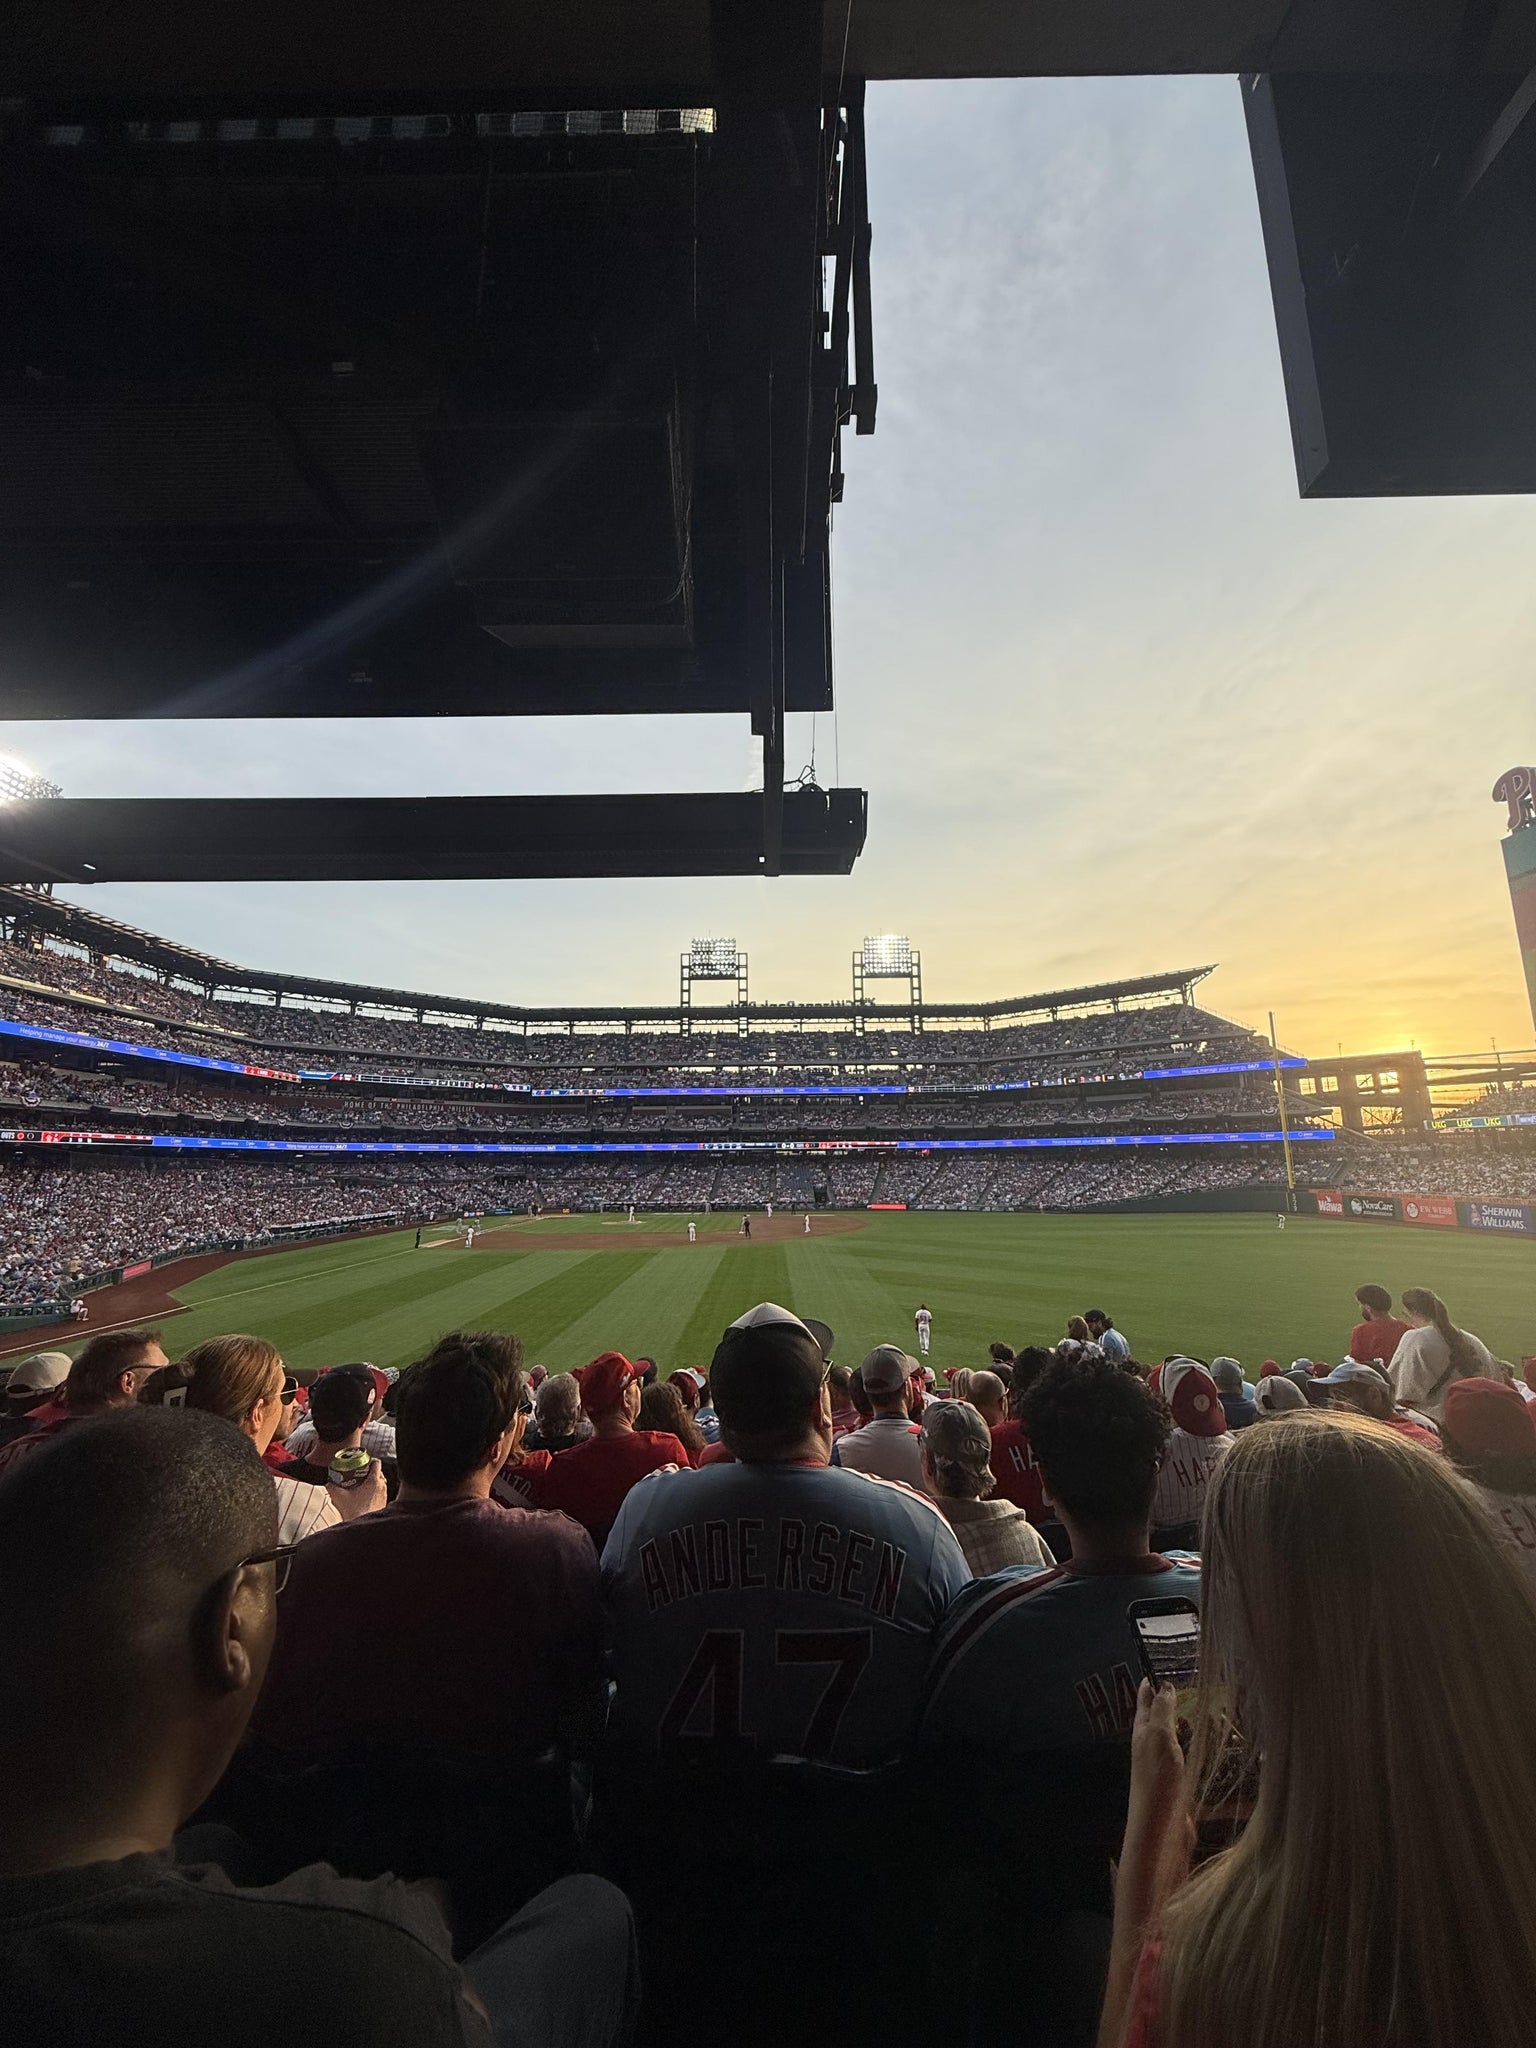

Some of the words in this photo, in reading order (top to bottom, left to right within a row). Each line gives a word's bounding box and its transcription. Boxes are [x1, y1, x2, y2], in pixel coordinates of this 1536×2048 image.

[20, 1027, 42, 1038] Helping
[43, 1032, 65, 1041] manage
[66, 1036, 78, 1044] your
[397, 1103, 444, 1111] PHILADELPHIA
[1457, 1119, 1472, 1127] UKG
[1484, 1117, 1501, 1126] UKG
[1318, 1200, 1343, 1212] Wawa
[1362, 1200, 1394, 1211] NovaCare
[1482, 1205, 1522, 1218] SHERWIN
[638, 1517, 907, 1620] ANDERSEN
[657, 1625, 874, 1760] 47
